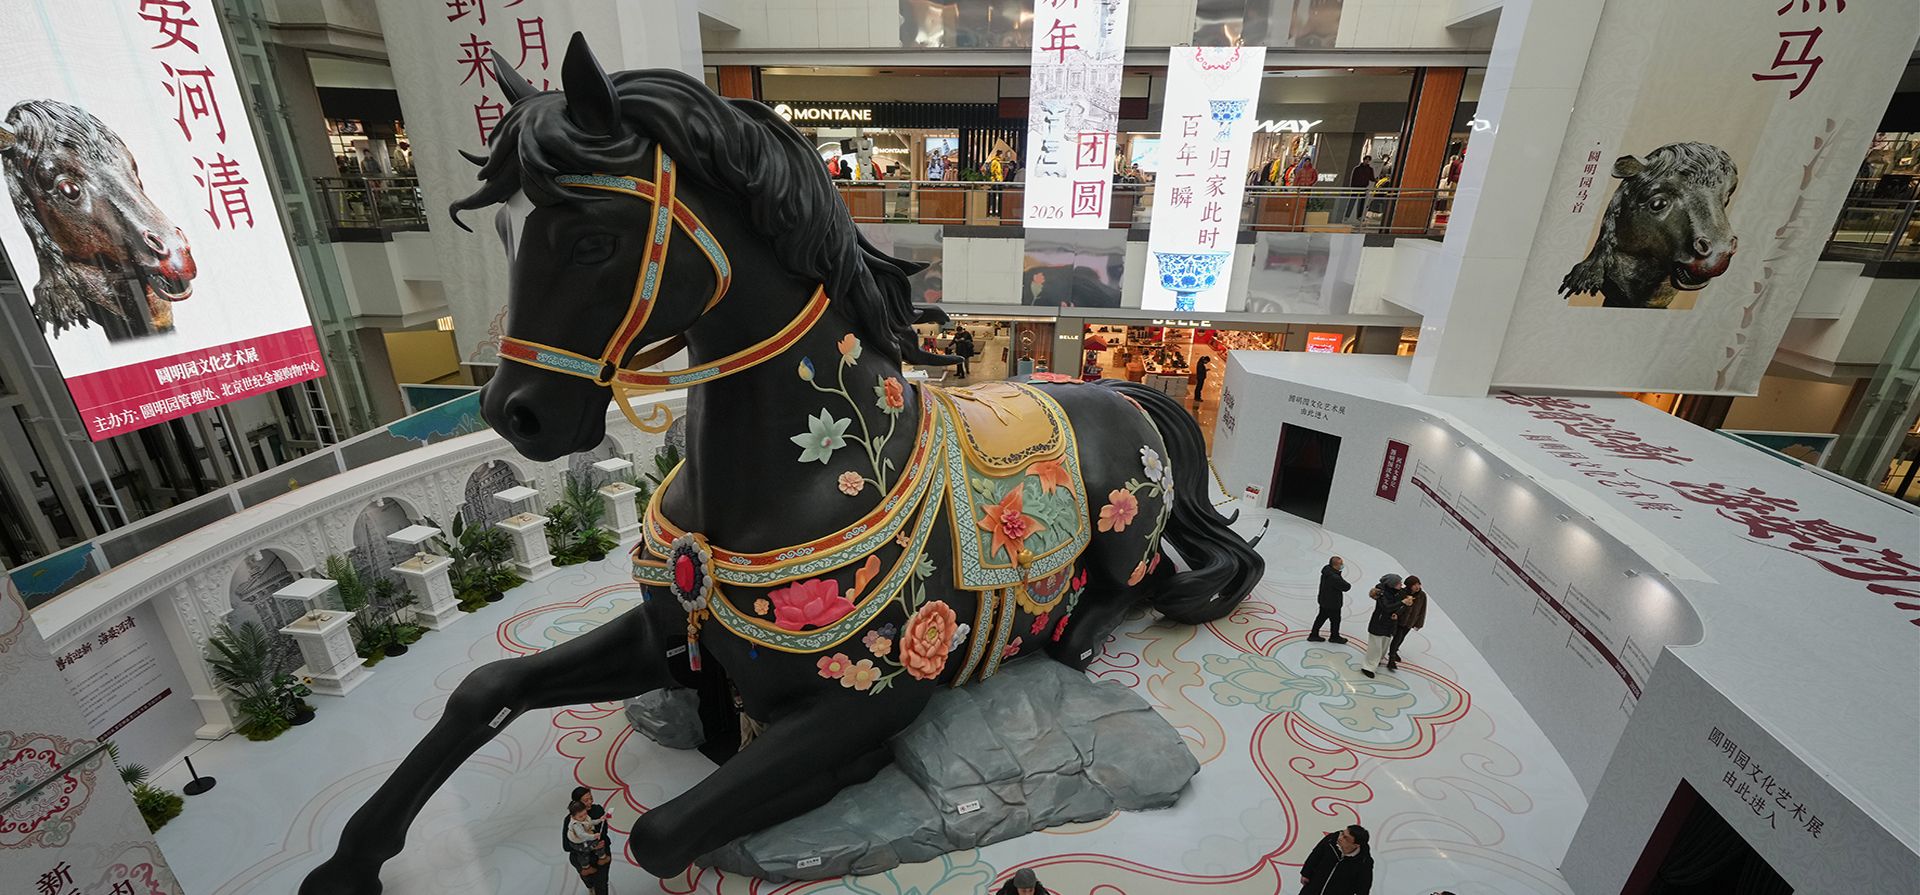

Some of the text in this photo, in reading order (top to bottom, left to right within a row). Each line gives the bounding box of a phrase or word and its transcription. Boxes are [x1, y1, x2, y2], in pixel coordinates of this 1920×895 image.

[1040, 0, 1080, 64] 年
[794, 108, 872, 121] MONTANE
[1071, 130, 1109, 220] 团圆
[1170, 114, 1203, 210] 百年一瞬
[1197, 146, 1231, 250] 归家此时
[1029, 205, 1064, 220] 2026
[155, 346, 260, 386] 圆明园文化艺术展
[1624, 467, 1920, 628] 海晏河
[1707, 725, 1826, 840] 圆明园文化艺术展
[1722, 770, 1778, 830] 由此进入
